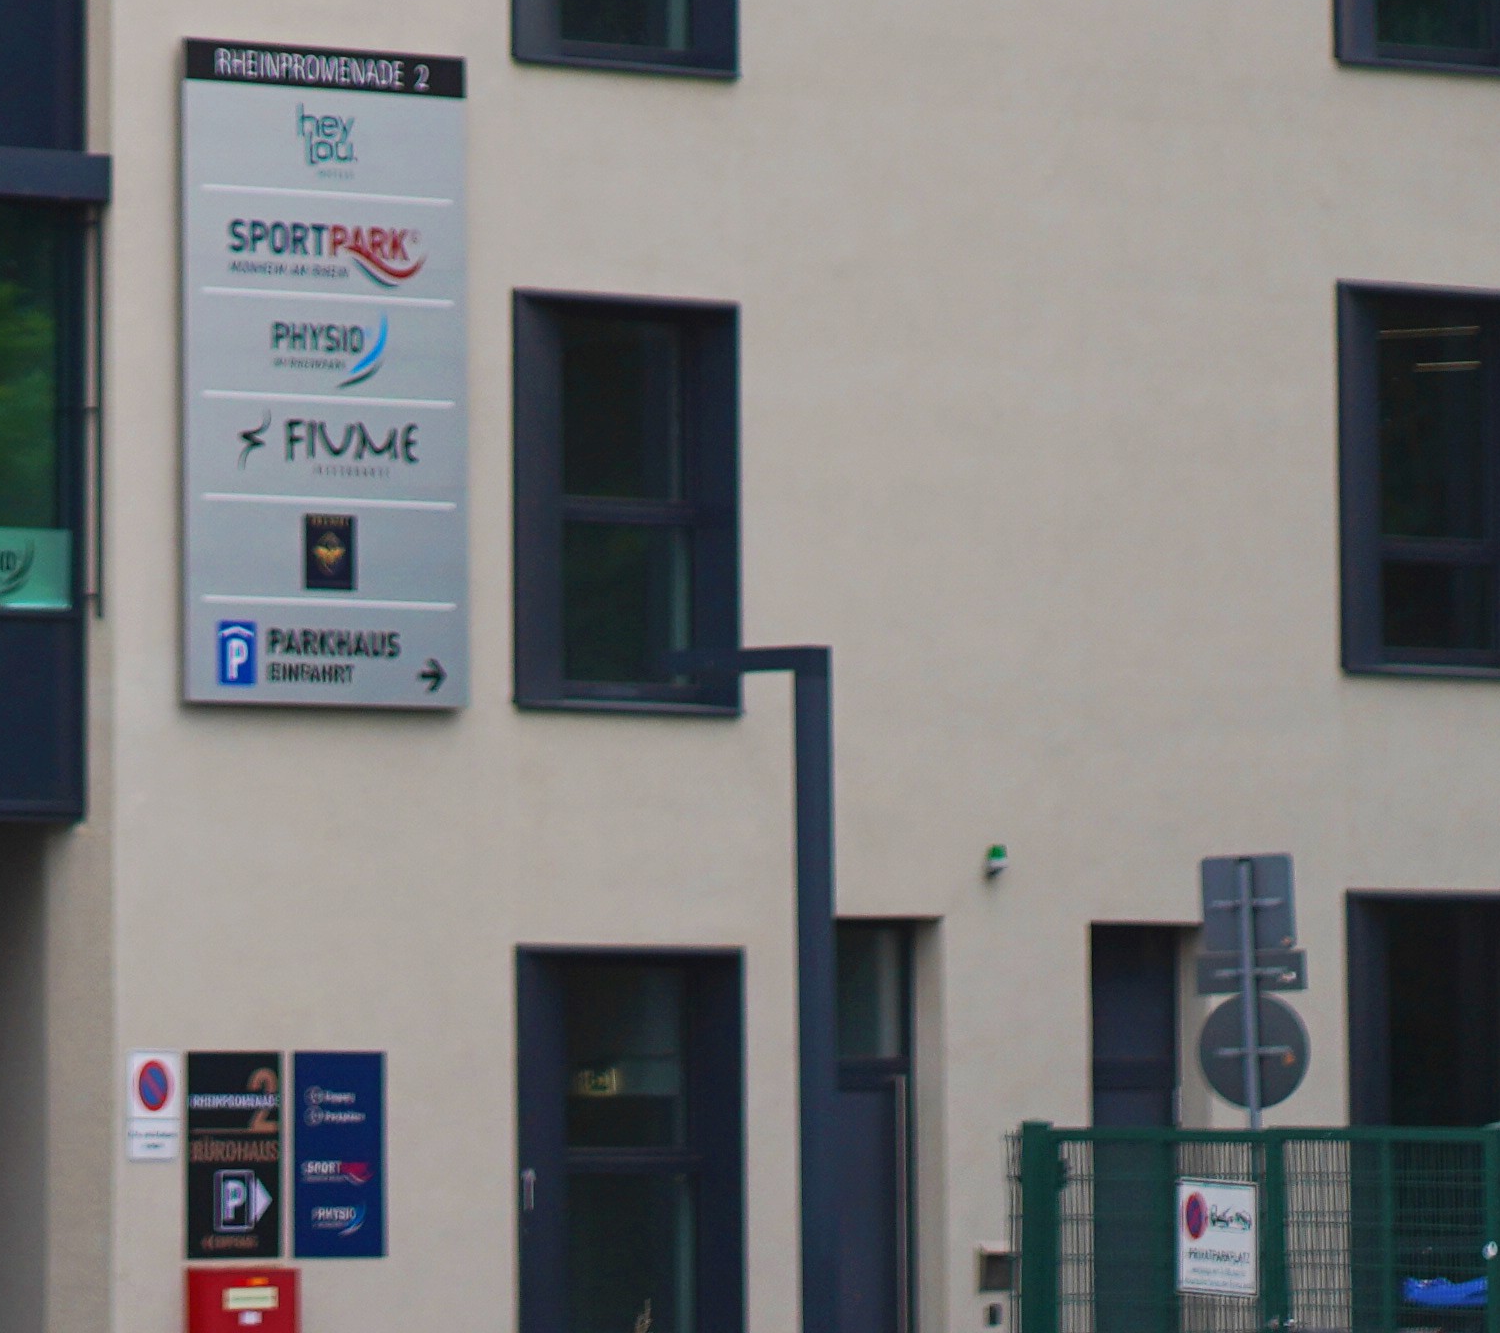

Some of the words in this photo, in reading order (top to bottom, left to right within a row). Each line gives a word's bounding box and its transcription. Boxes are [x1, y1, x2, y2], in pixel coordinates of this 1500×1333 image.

[214, 47, 405, 87] RHEINPROMENADE
[413, 63, 431, 91] 2
[297, 102, 356, 143] hey
[271, 322, 364, 354] PHYSIO
[284, 417, 421, 465] FIUME
[266, 627, 402, 660] PARKHAUS
[266, 662, 355, 684] EINFAHRT
